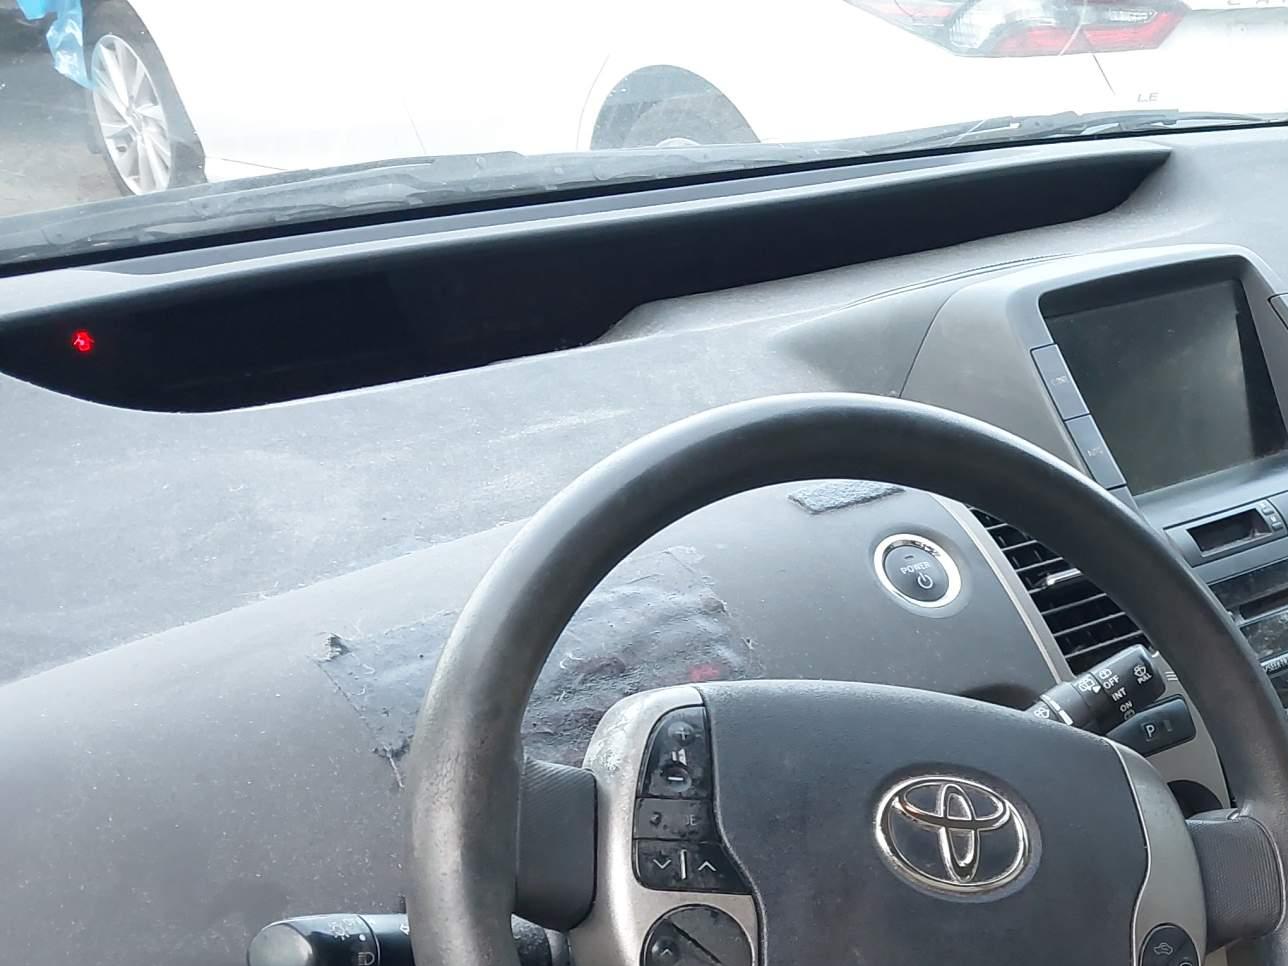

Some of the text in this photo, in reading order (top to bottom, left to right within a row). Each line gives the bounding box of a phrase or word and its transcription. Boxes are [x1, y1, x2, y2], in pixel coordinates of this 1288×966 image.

[1137, 92, 1160, 102] LE
[900, 561, 930, 575] POWER
[1103, 675, 1119, 690] OFF
[1112, 687, 1127, 701] INT
[1120, 700, 1133, 713] ON
[1145, 724, 1156, 738] P
